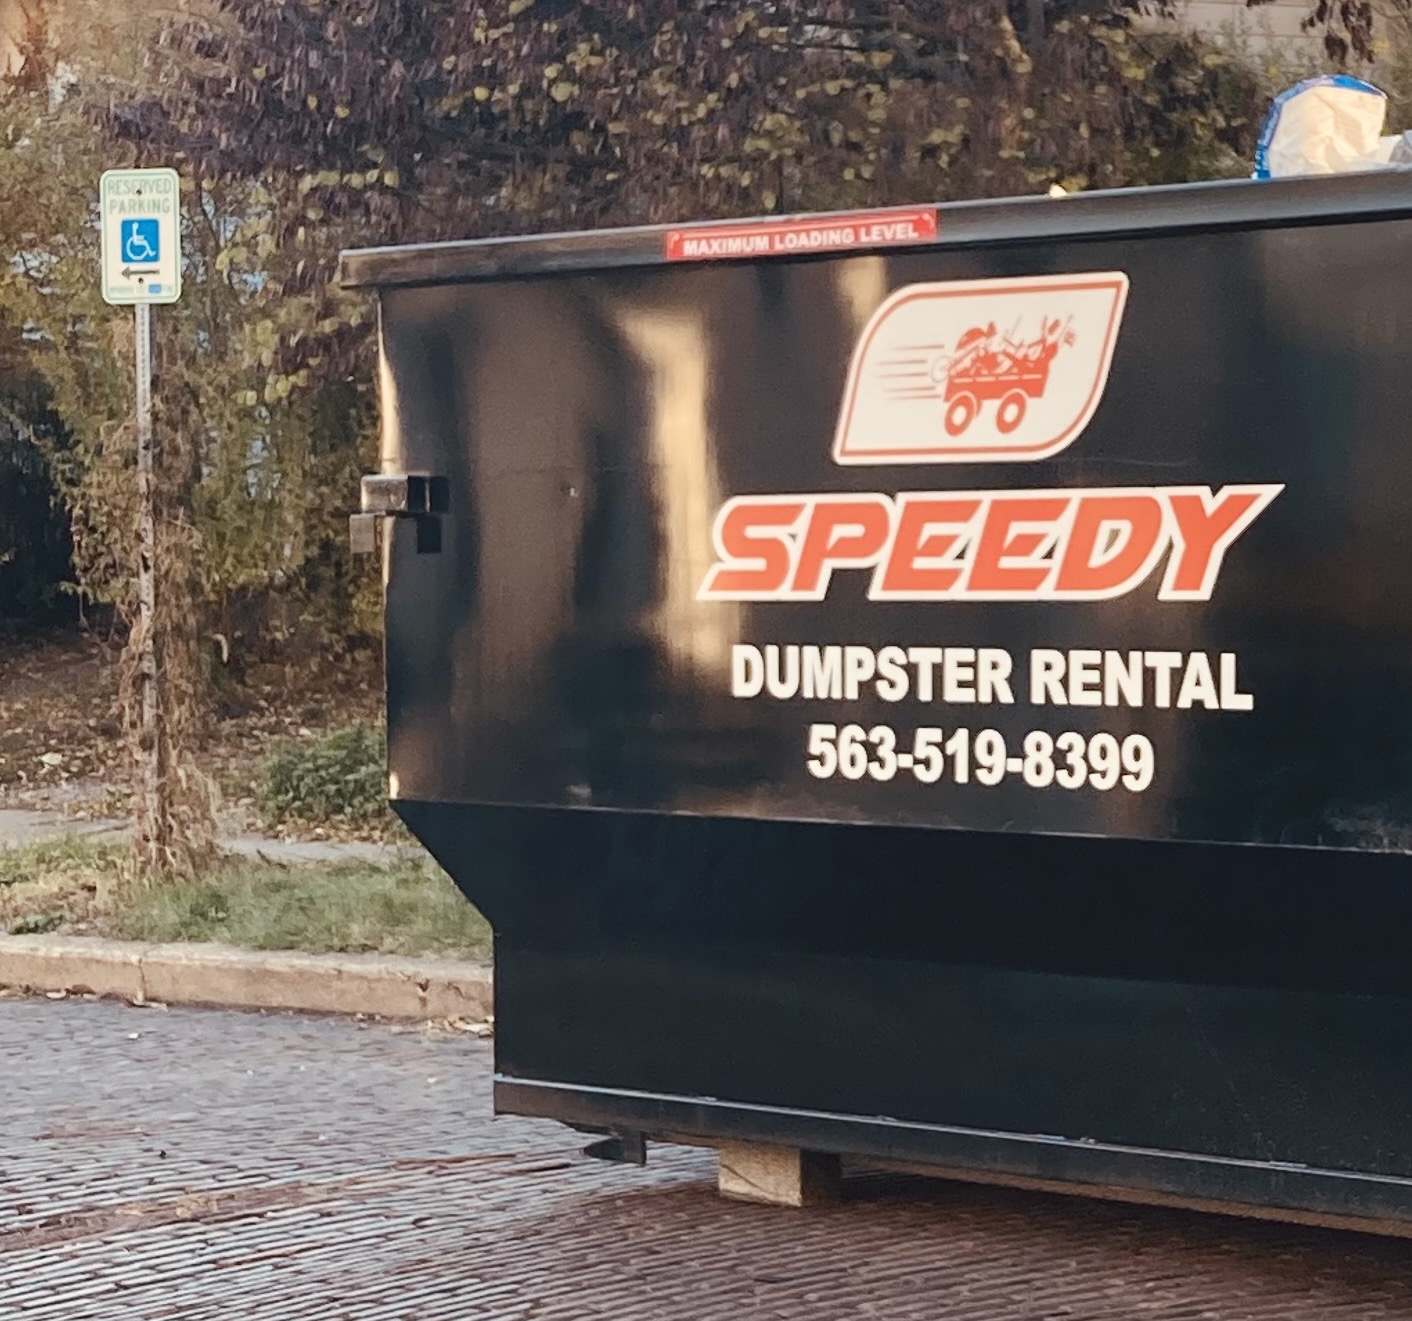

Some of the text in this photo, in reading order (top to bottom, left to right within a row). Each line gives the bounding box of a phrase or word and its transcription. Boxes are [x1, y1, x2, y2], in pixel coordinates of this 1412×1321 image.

[107, 178, 172, 195] RESERVED
[109, 198, 171, 215] PARKING
[683, 222, 919, 257] MAXIMUM LOADING LEVEL
[696, 484, 1285, 602] SPEEDY
[731, 644, 1254, 711] DUMPSTER RENTAL
[806, 723, 1155, 792] 563-519-8399
